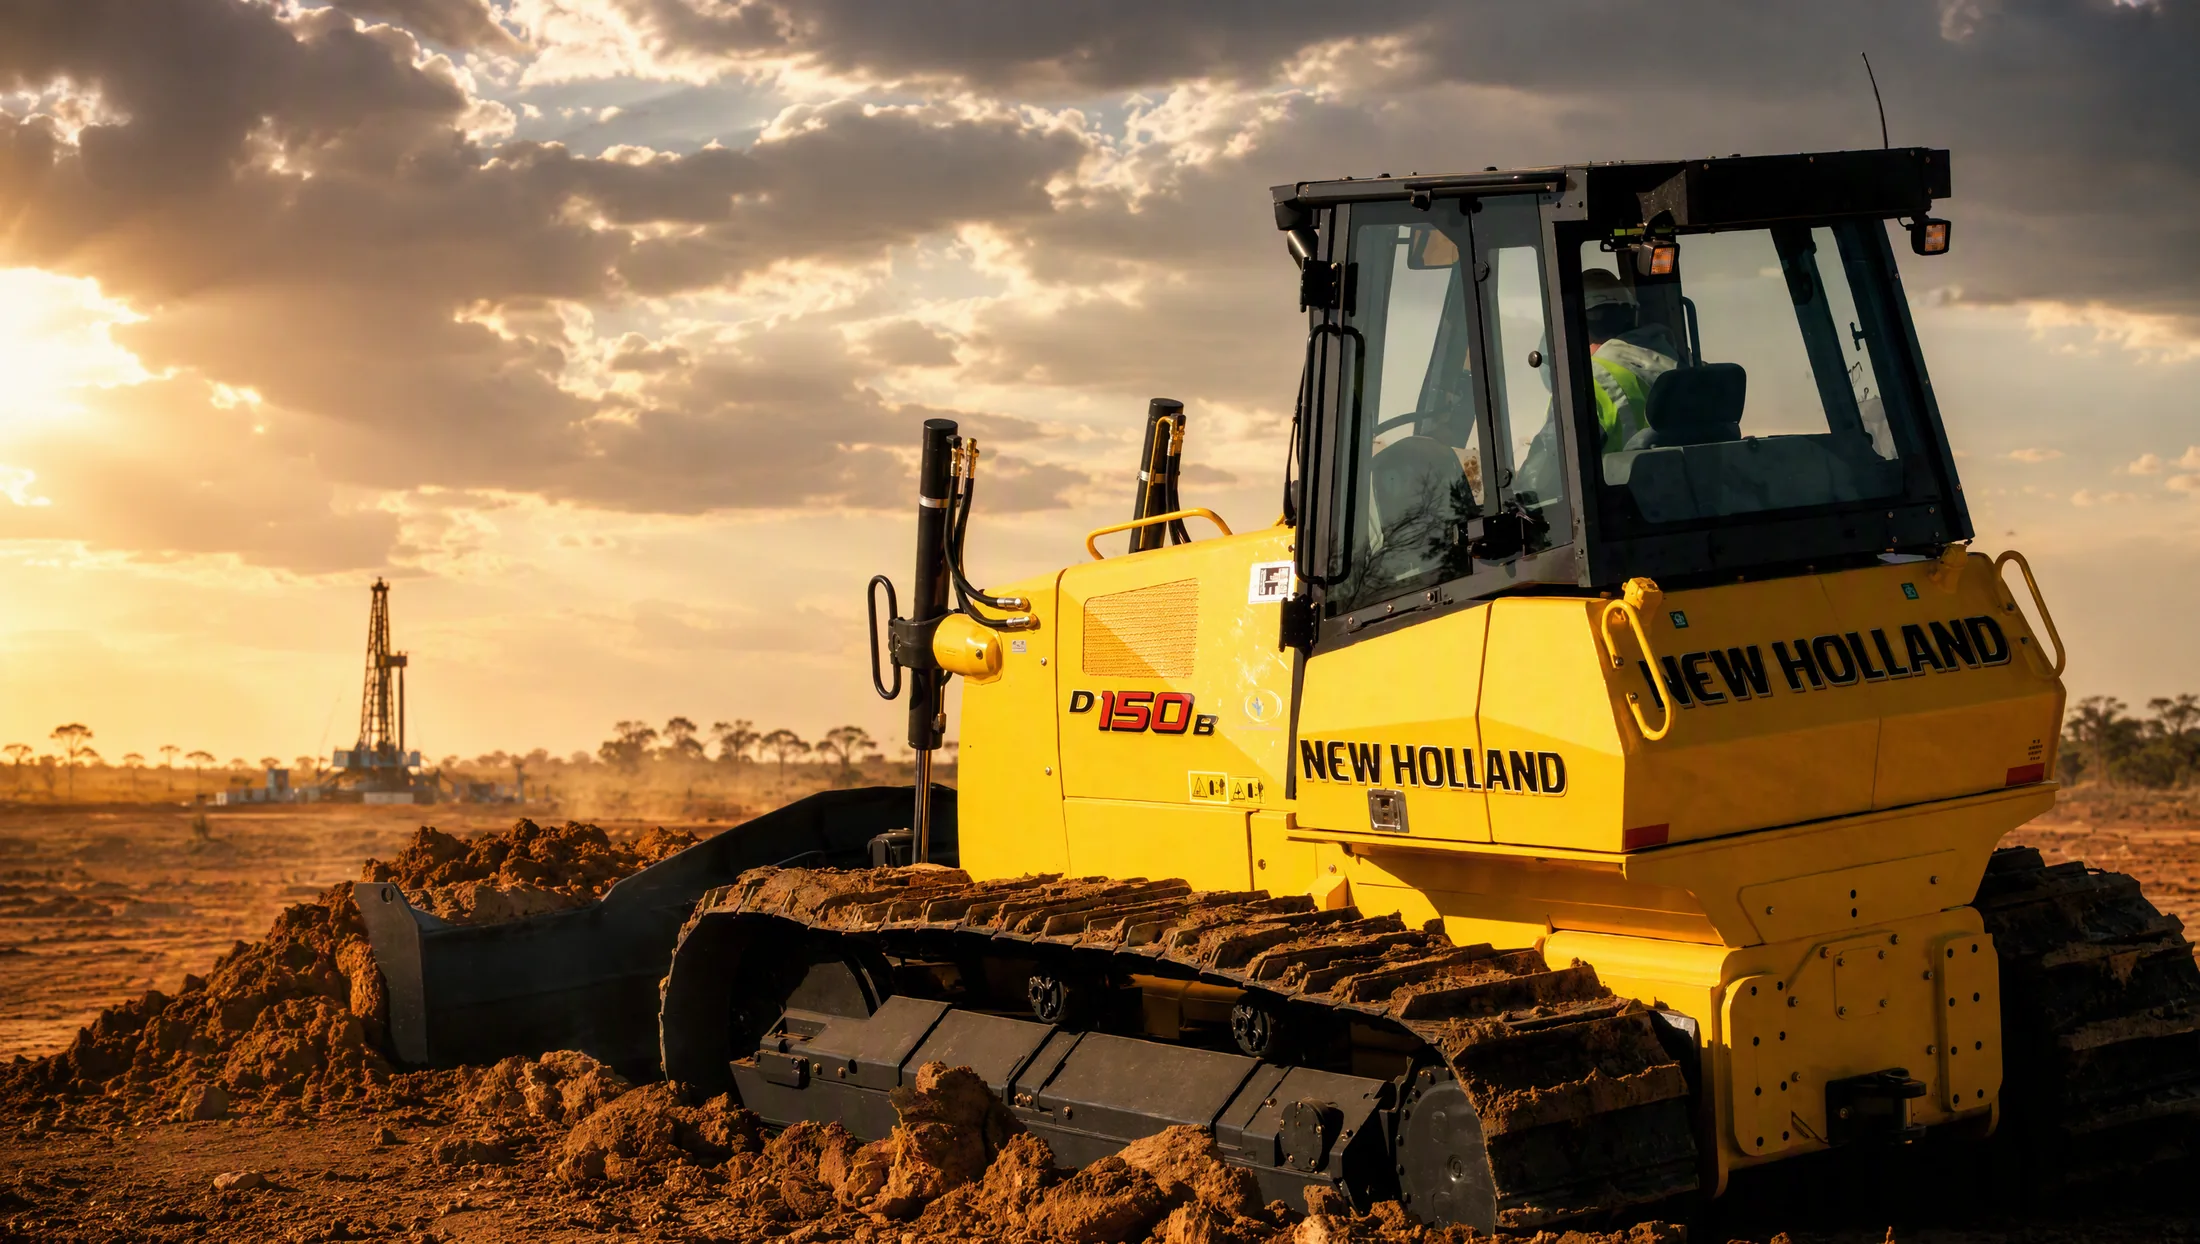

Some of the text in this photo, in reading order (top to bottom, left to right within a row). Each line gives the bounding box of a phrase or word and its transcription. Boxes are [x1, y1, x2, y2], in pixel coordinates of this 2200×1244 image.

[1638, 615, 2011, 711] NEW HOLLAND
[1300, 739, 1567, 797] NEW HOLLAND
